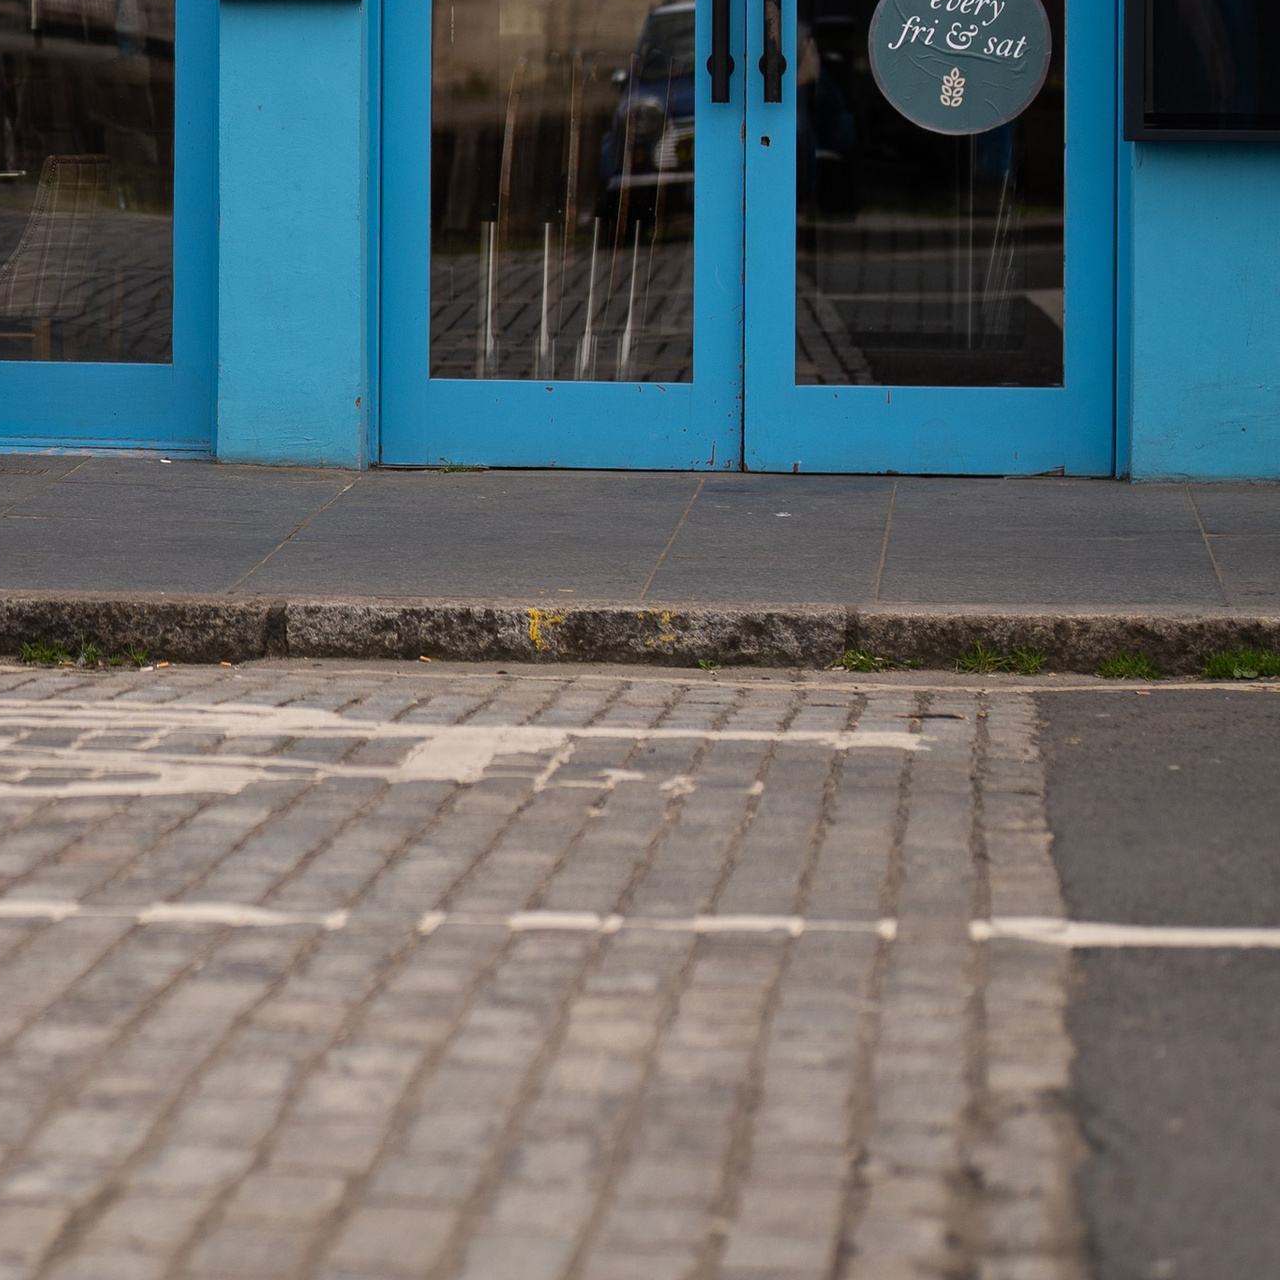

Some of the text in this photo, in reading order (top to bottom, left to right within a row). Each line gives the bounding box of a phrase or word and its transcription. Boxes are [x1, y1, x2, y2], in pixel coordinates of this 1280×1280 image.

[888, 15, 1028, 59] fri & sat
